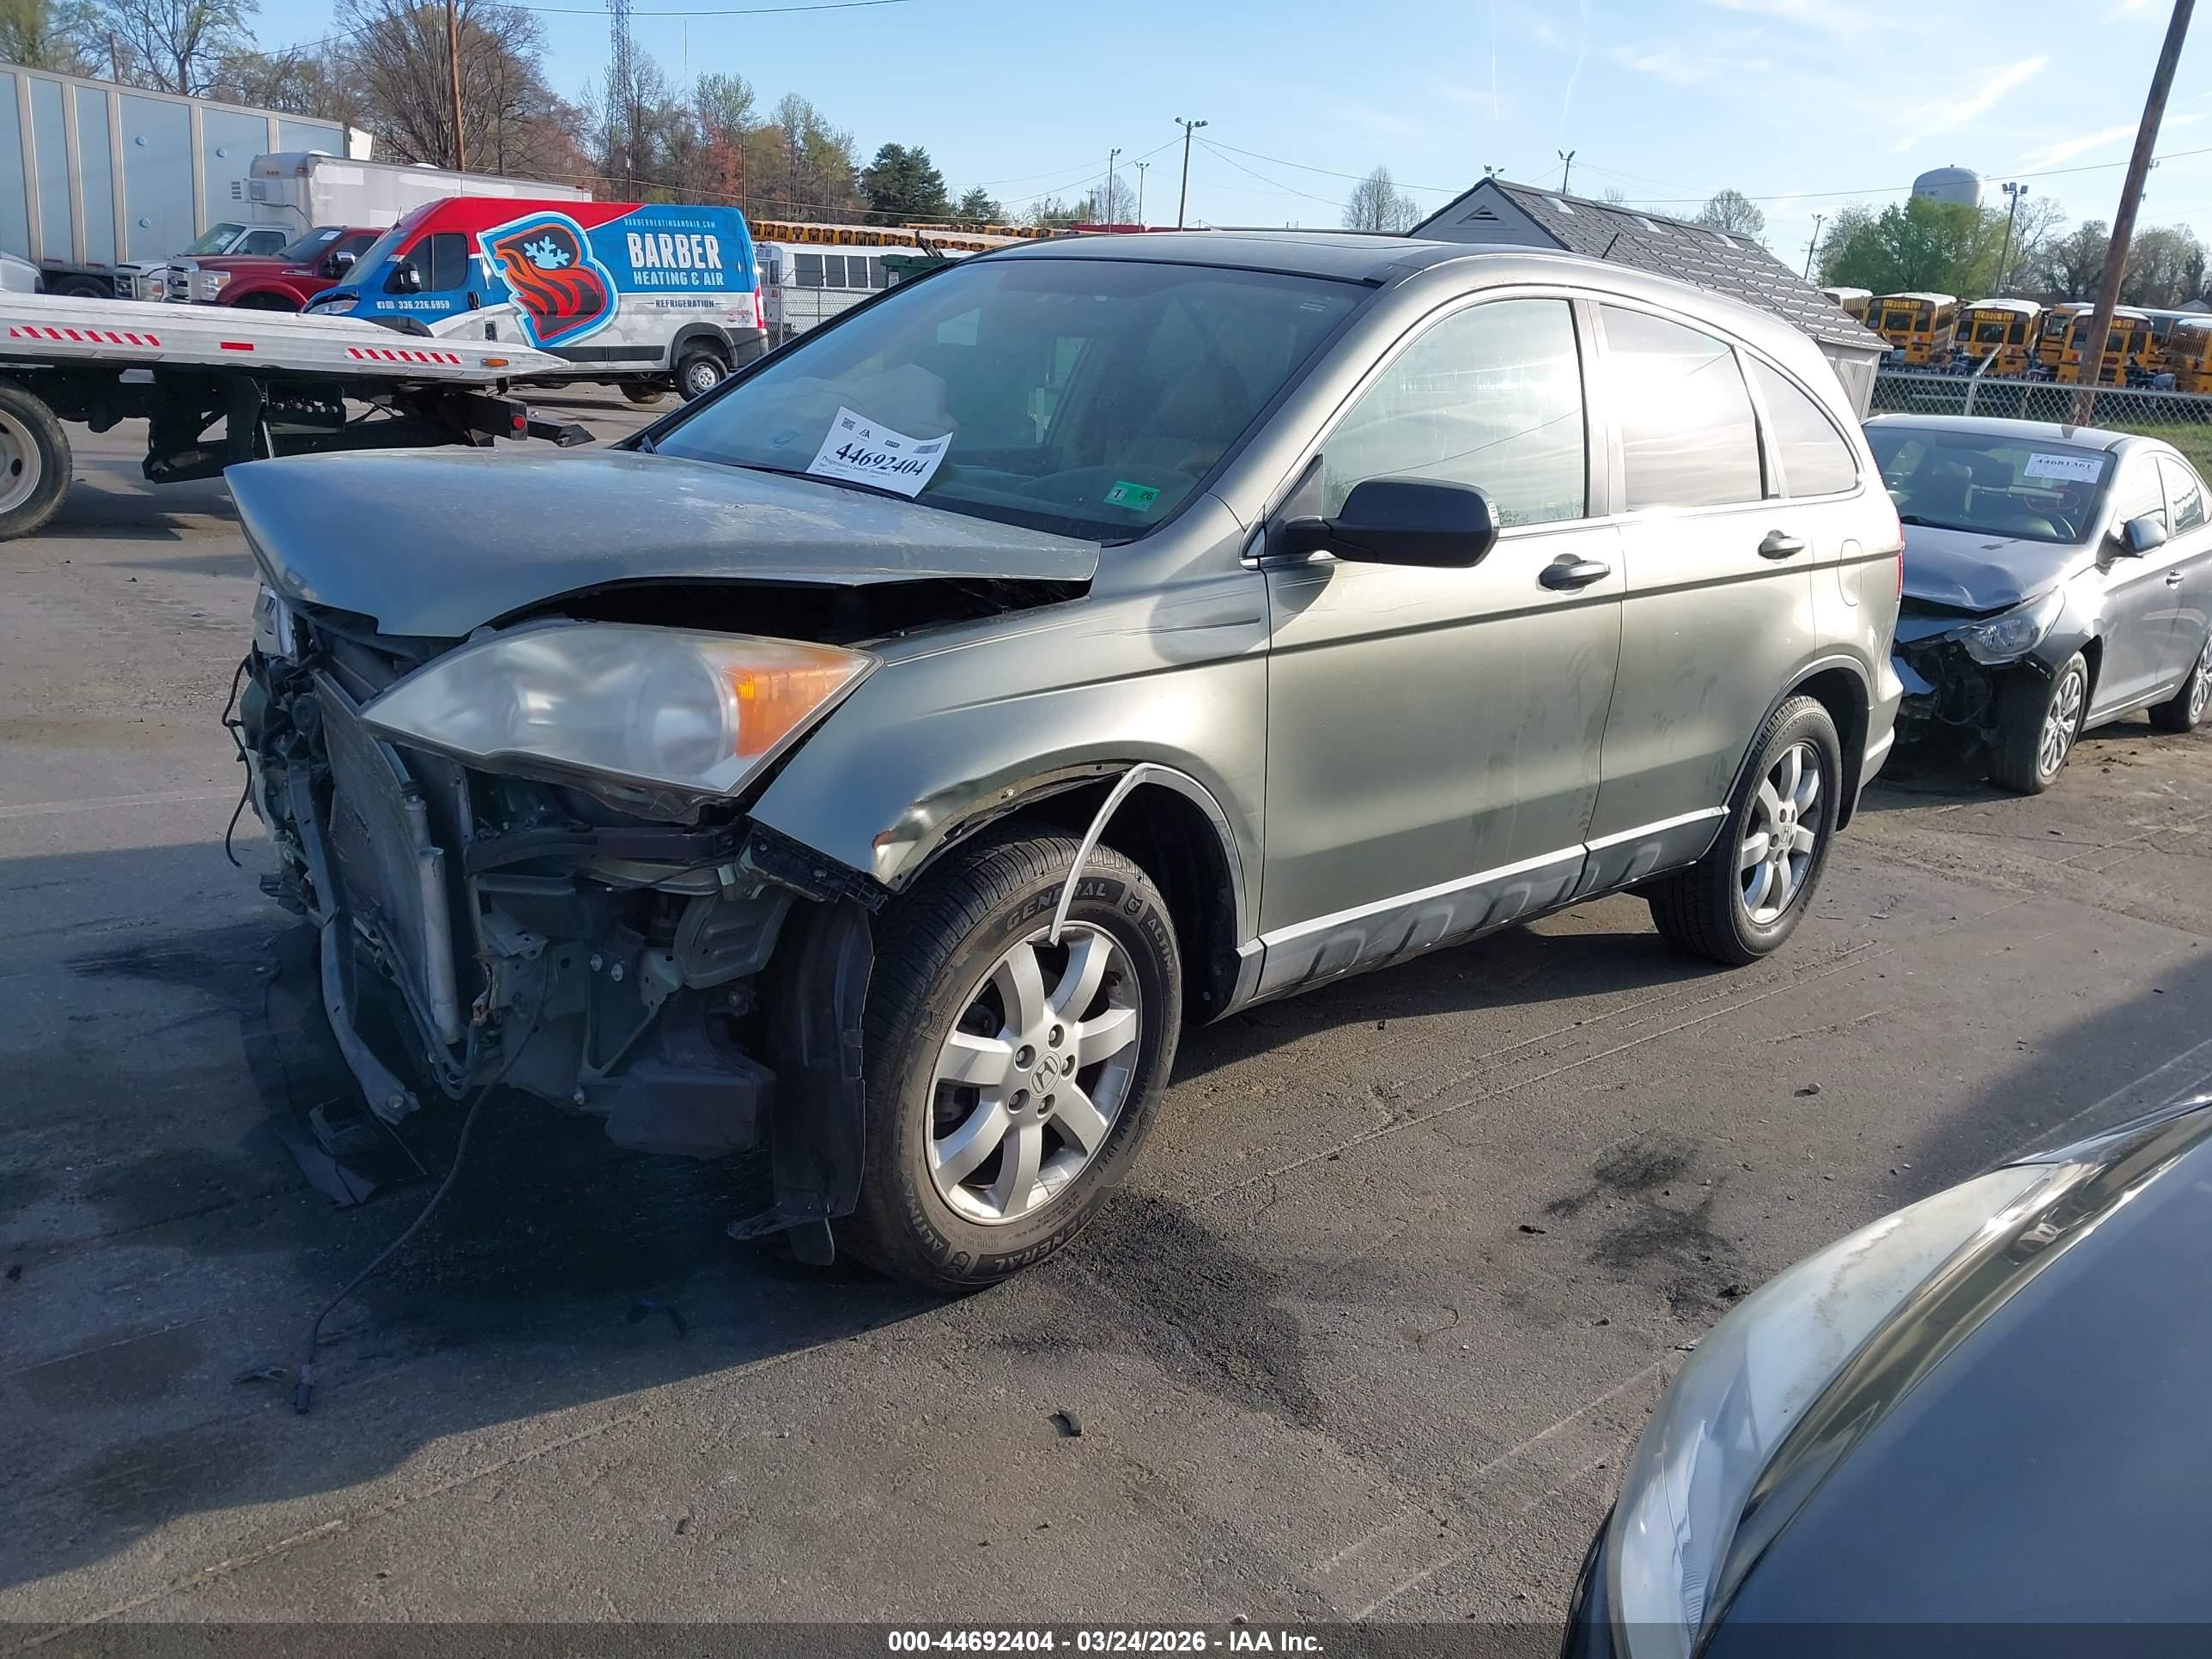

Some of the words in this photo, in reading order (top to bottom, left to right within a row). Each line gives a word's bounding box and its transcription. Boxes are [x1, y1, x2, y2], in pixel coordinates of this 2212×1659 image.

[626, 233, 723, 270] BARBER
[633, 270, 687, 286] HEATING
[691, 272, 699, 286] &
[703, 272, 725, 286] AIR
[398, 300, 450, 310] 336.226.6959
[655, 299, 714, 308] REFRIGERATION
[836, 442, 931, 477] 44692404
